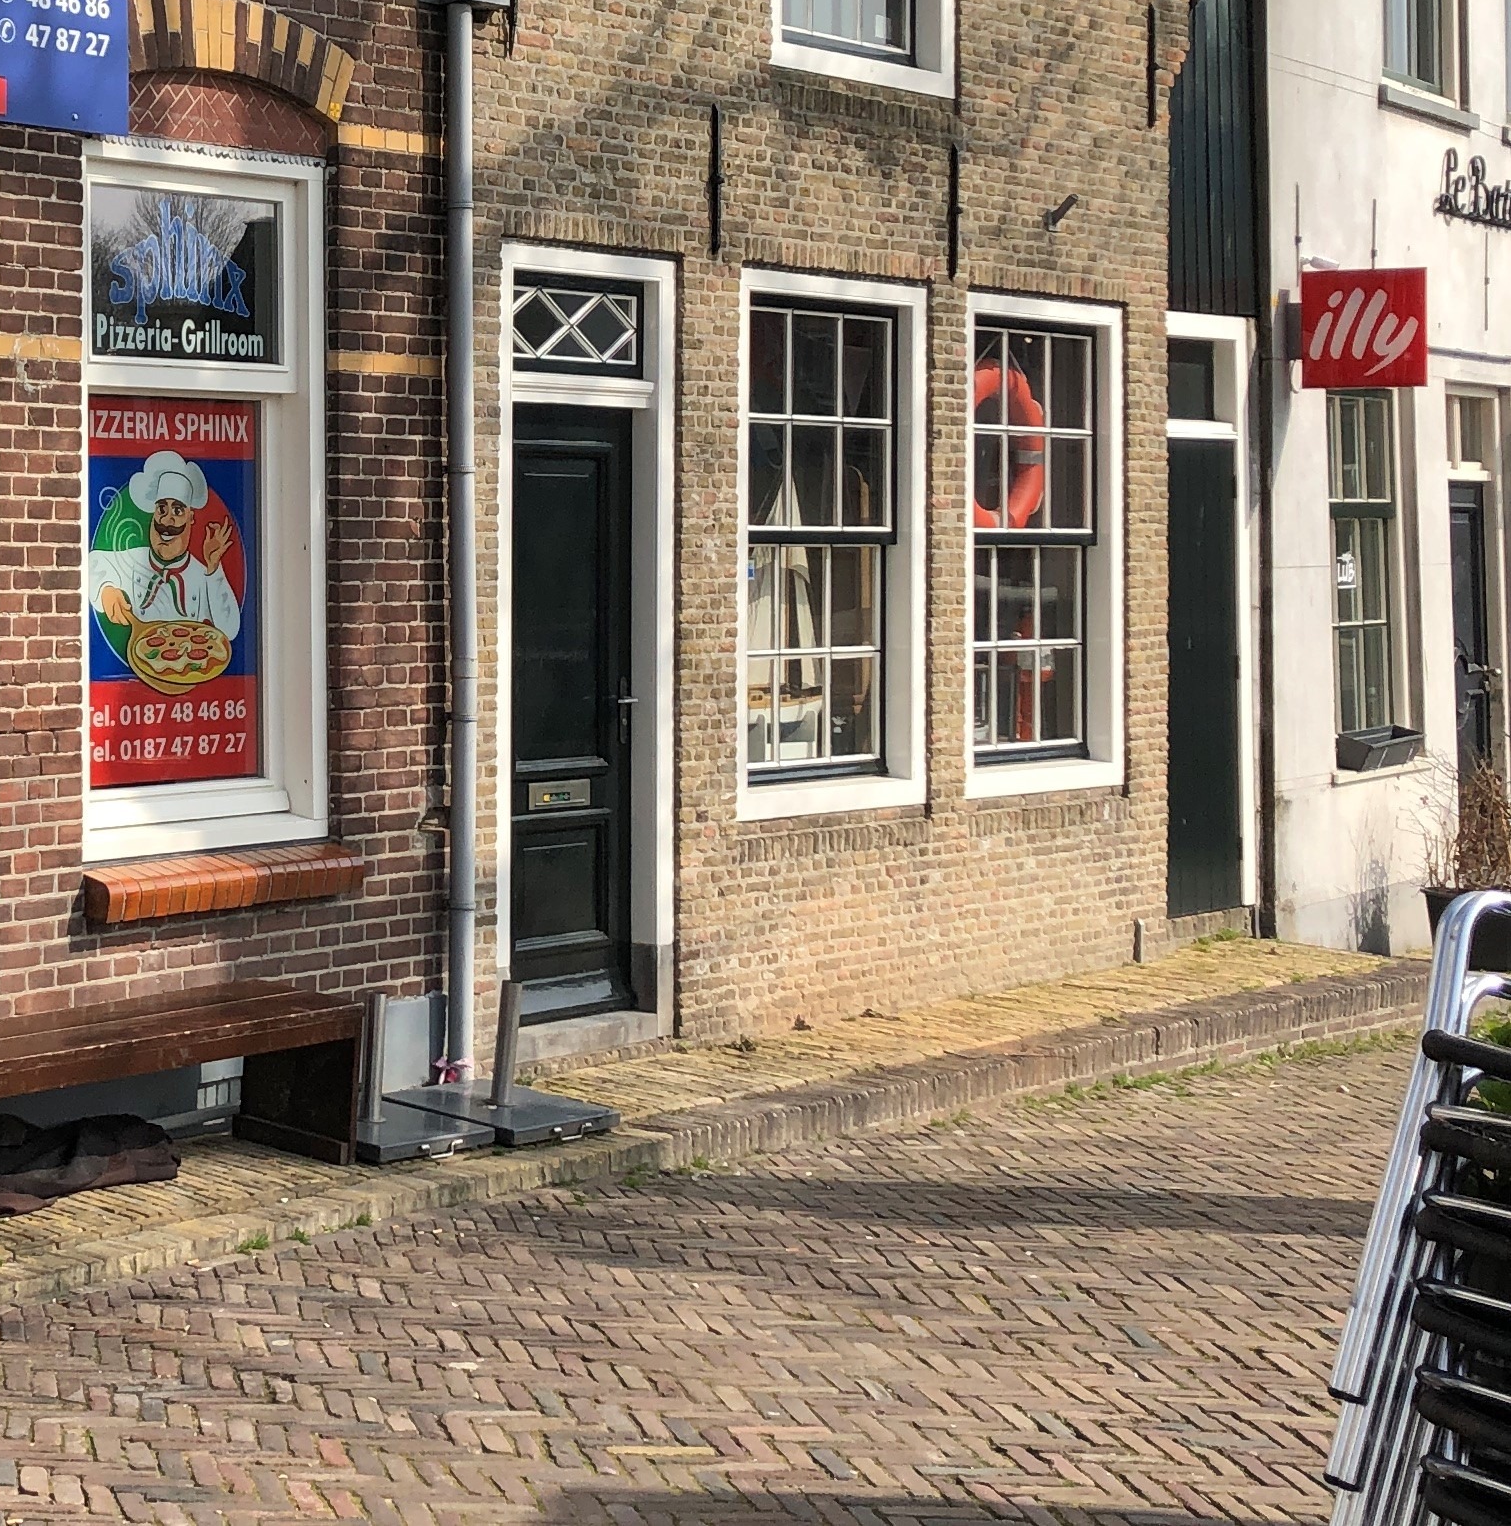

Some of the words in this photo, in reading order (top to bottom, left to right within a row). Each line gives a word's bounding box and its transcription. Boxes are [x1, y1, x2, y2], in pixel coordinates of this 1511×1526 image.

[25, 23, 51, 48] 47
[56, 28, 81, 53] 87
[85, 32, 110, 57] 27
[109, 197, 251, 324] sphinx
[1309, 287, 1419, 376] illy
[90, 410, 170, 440] IZZERIA
[174, 412, 249, 443] SPHINX
[120, 704, 166, 726] 0187
[171, 702, 194, 723] 48
[198, 700, 220, 721] 46
[224, 698, 247, 720] 86
[120, 737, 167, 761] 0187
[171, 736, 194, 757] 47
[198, 734, 221, 755] 87
[225, 732, 247, 753] 27
